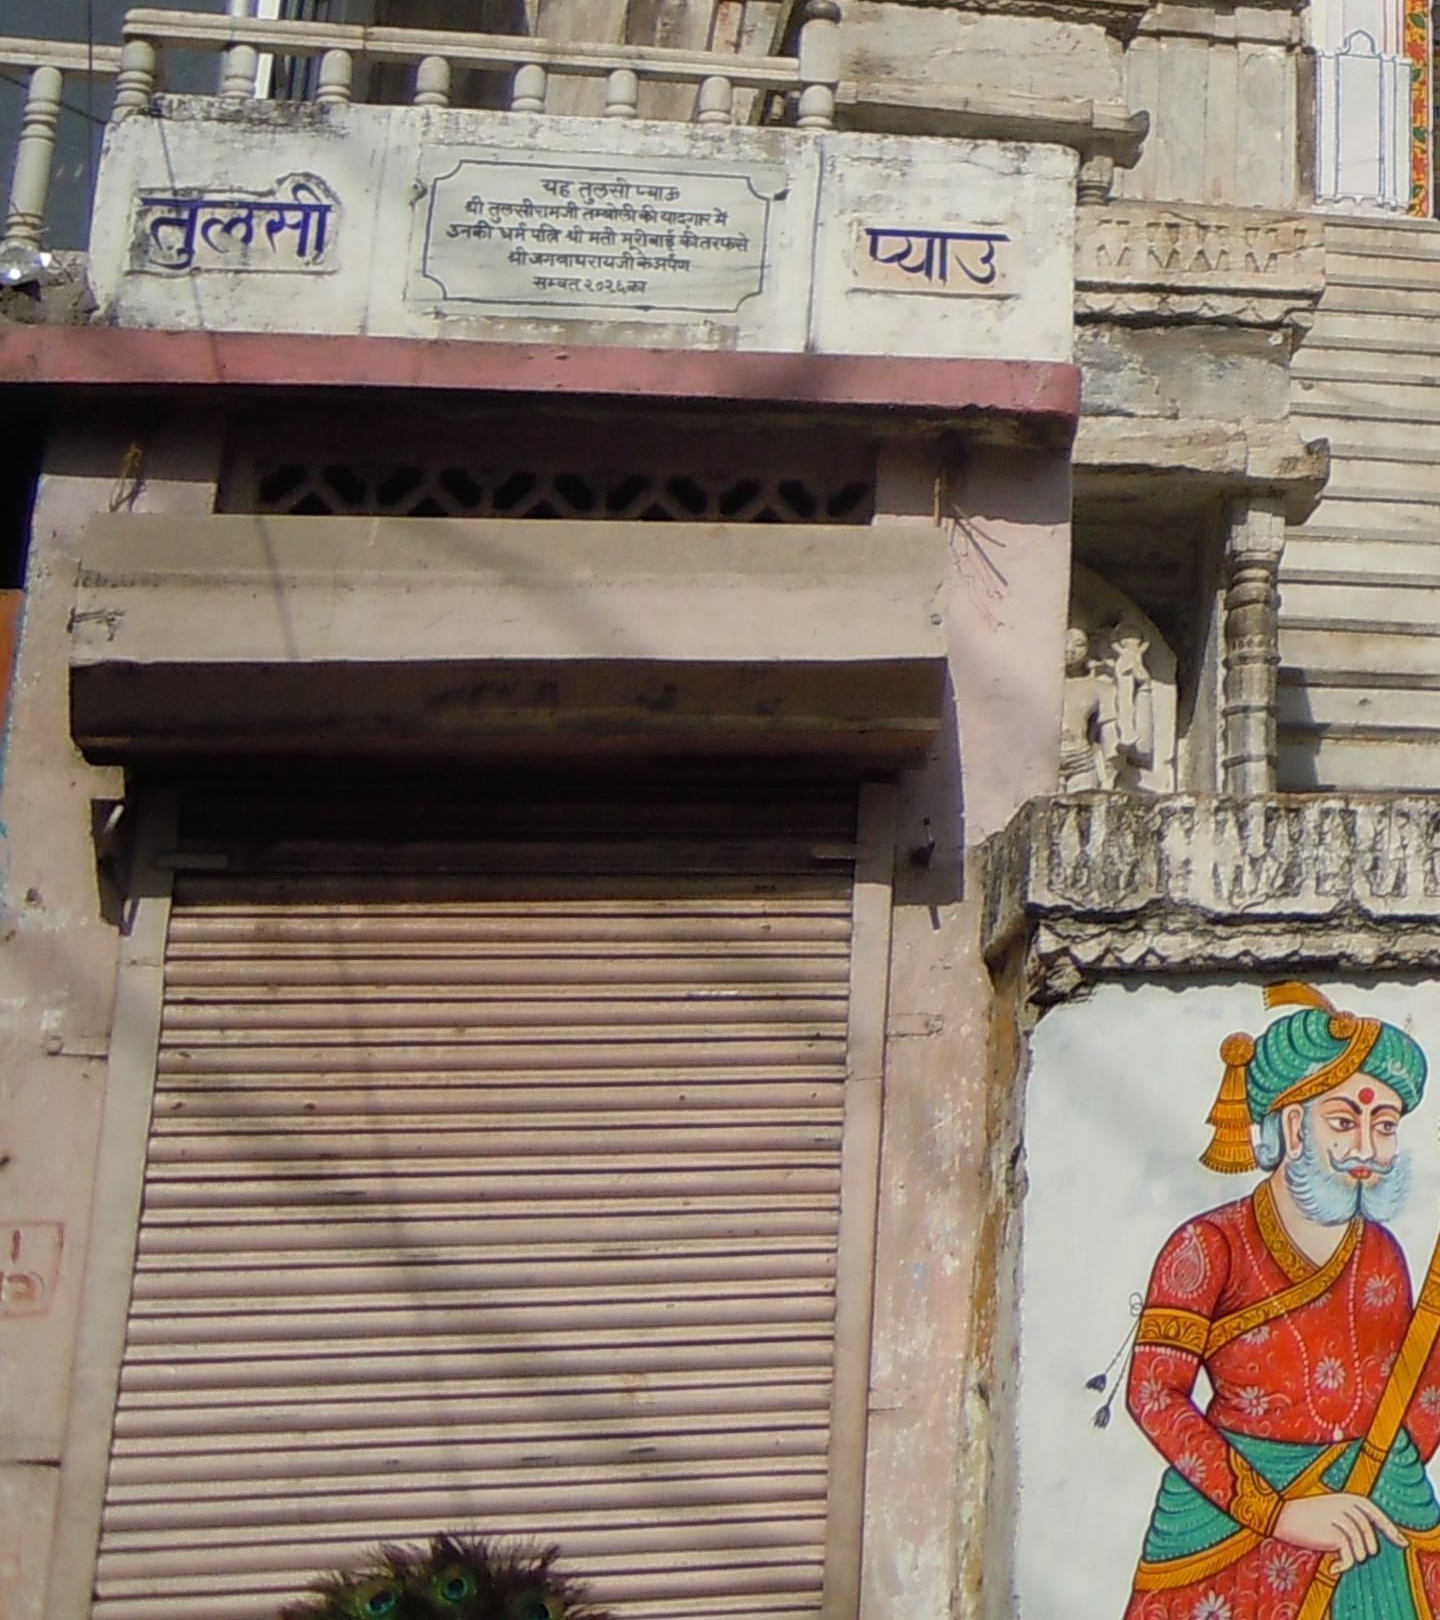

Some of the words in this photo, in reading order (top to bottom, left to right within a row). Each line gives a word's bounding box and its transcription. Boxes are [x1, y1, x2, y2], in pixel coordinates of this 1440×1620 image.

[542, 178, 571, 198] यह
[578, 177, 630, 205] तुलसी
[140, 182, 332, 270] तुलसी
[447, 221, 492, 241] उनकी
[864, 228, 1011, 285] प्याउ
